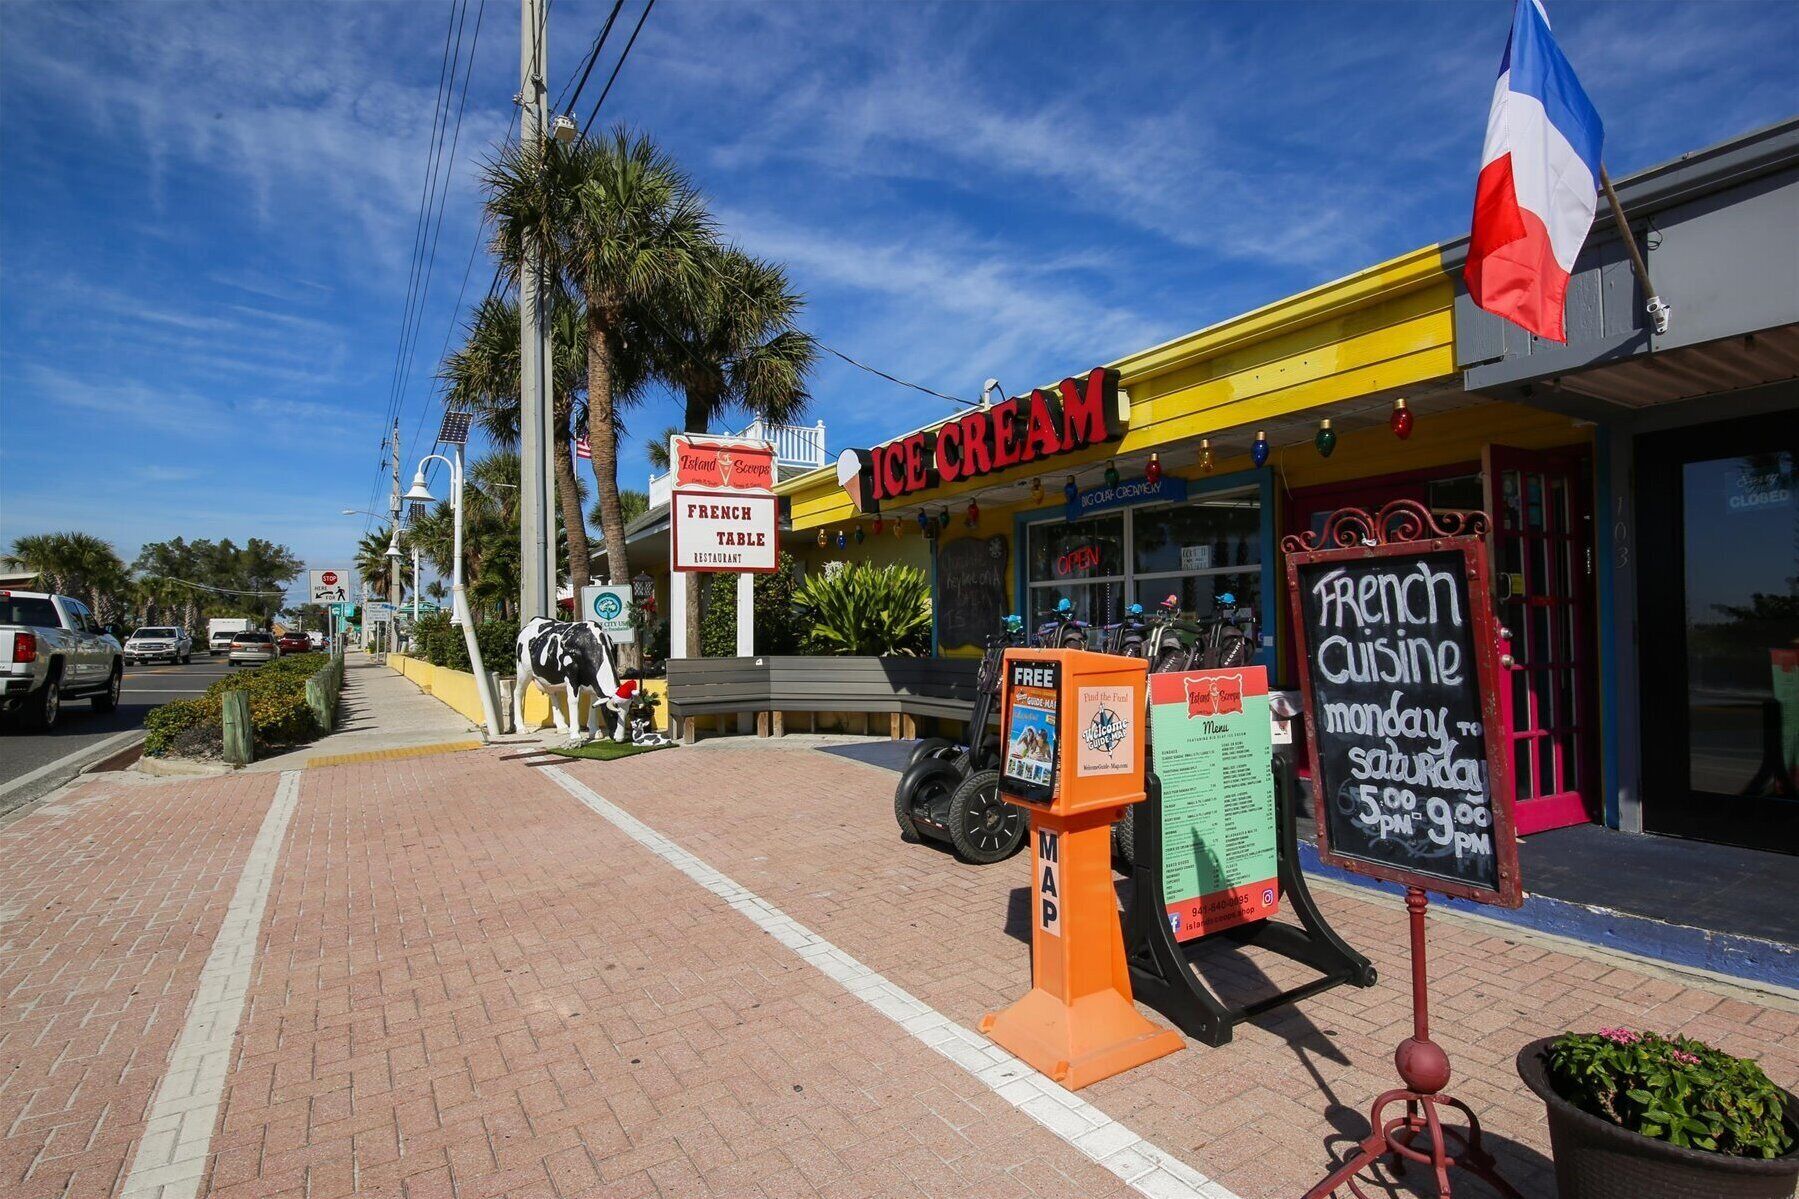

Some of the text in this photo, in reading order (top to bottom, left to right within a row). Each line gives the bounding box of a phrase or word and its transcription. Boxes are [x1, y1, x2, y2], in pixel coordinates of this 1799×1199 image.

[871, 366, 1109, 500] ICE CREAM
[681, 455, 770, 477] Island Scoops
[1729, 489, 1790, 508] CLOSED
[687, 504, 752, 520] FRENCH
[716, 532, 765, 547] TABLE
[1614, 496, 1629, 568] 103
[694, 552, 742, 564] RESTAURANT
[1057, 546, 1100, 576] OPEN
[1014, 667, 1054, 688] FREE
[1084, 691, 1099, 702] Find
[1100, 692, 1111, 701] the
[1189, 691, 1210, 704] Island
[1082, 718, 1128, 742] Welcome
[1203, 721, 1229, 735] Menu
[1038, 830, 1058, 929] MAP
